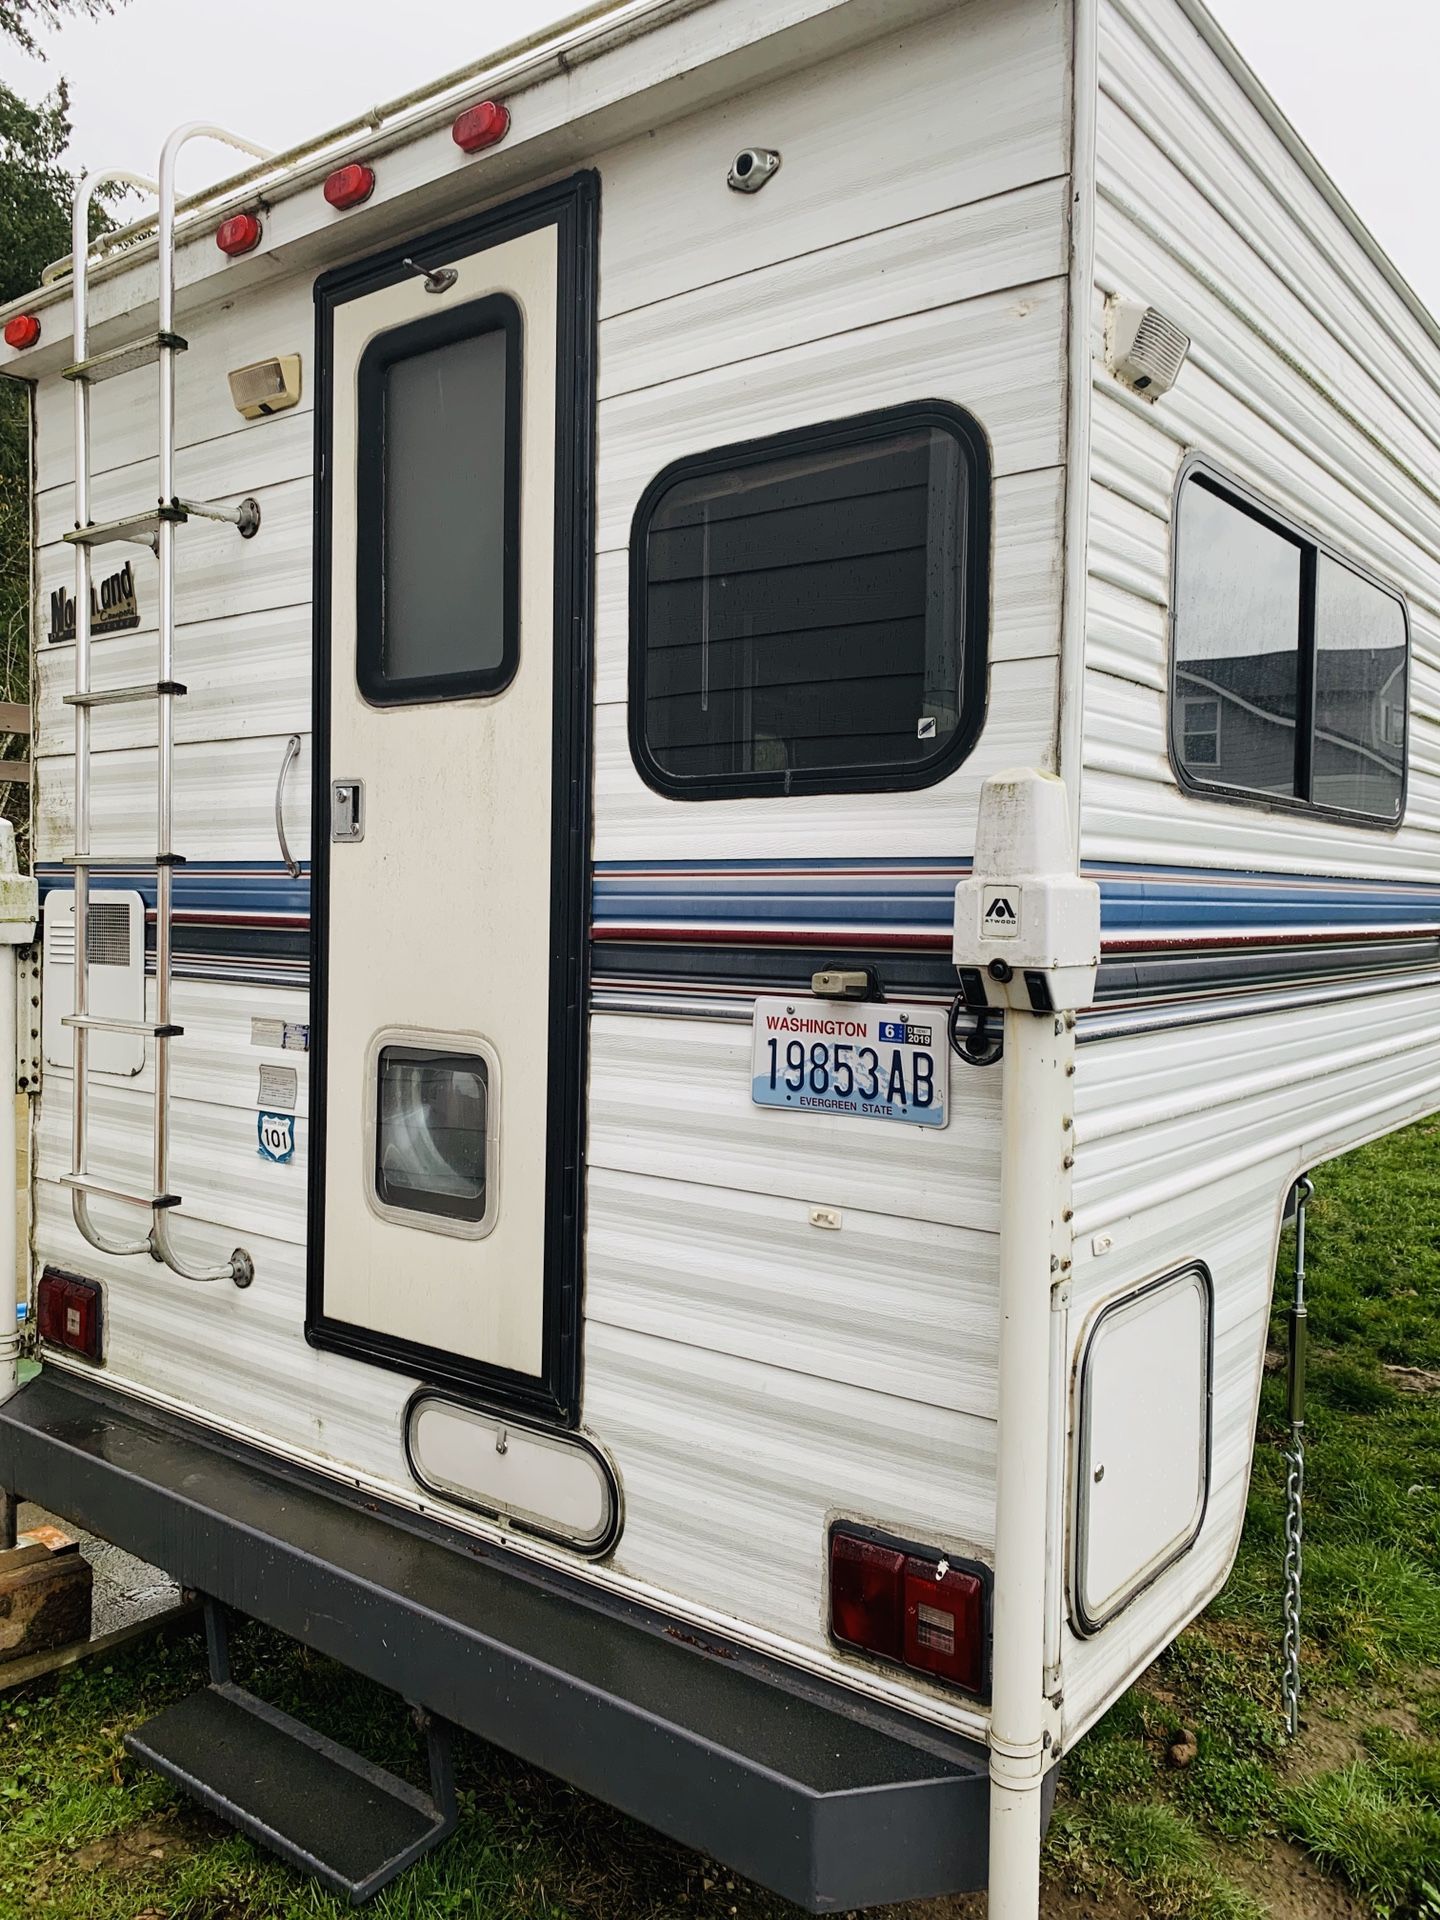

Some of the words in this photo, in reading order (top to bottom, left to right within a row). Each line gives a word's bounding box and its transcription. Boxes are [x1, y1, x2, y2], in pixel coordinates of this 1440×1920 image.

[767, 1016, 867, 1037] WASHINGTON
[885, 1024, 895, 1038] 6
[908, 1034, 930, 1045] 2019
[768, 1037, 934, 1108] 19853AB
[800, 1097, 857, 1111] EVERGREEN
[862, 1105, 893, 1116] STATE
[265, 1129, 287, 1149] 101
